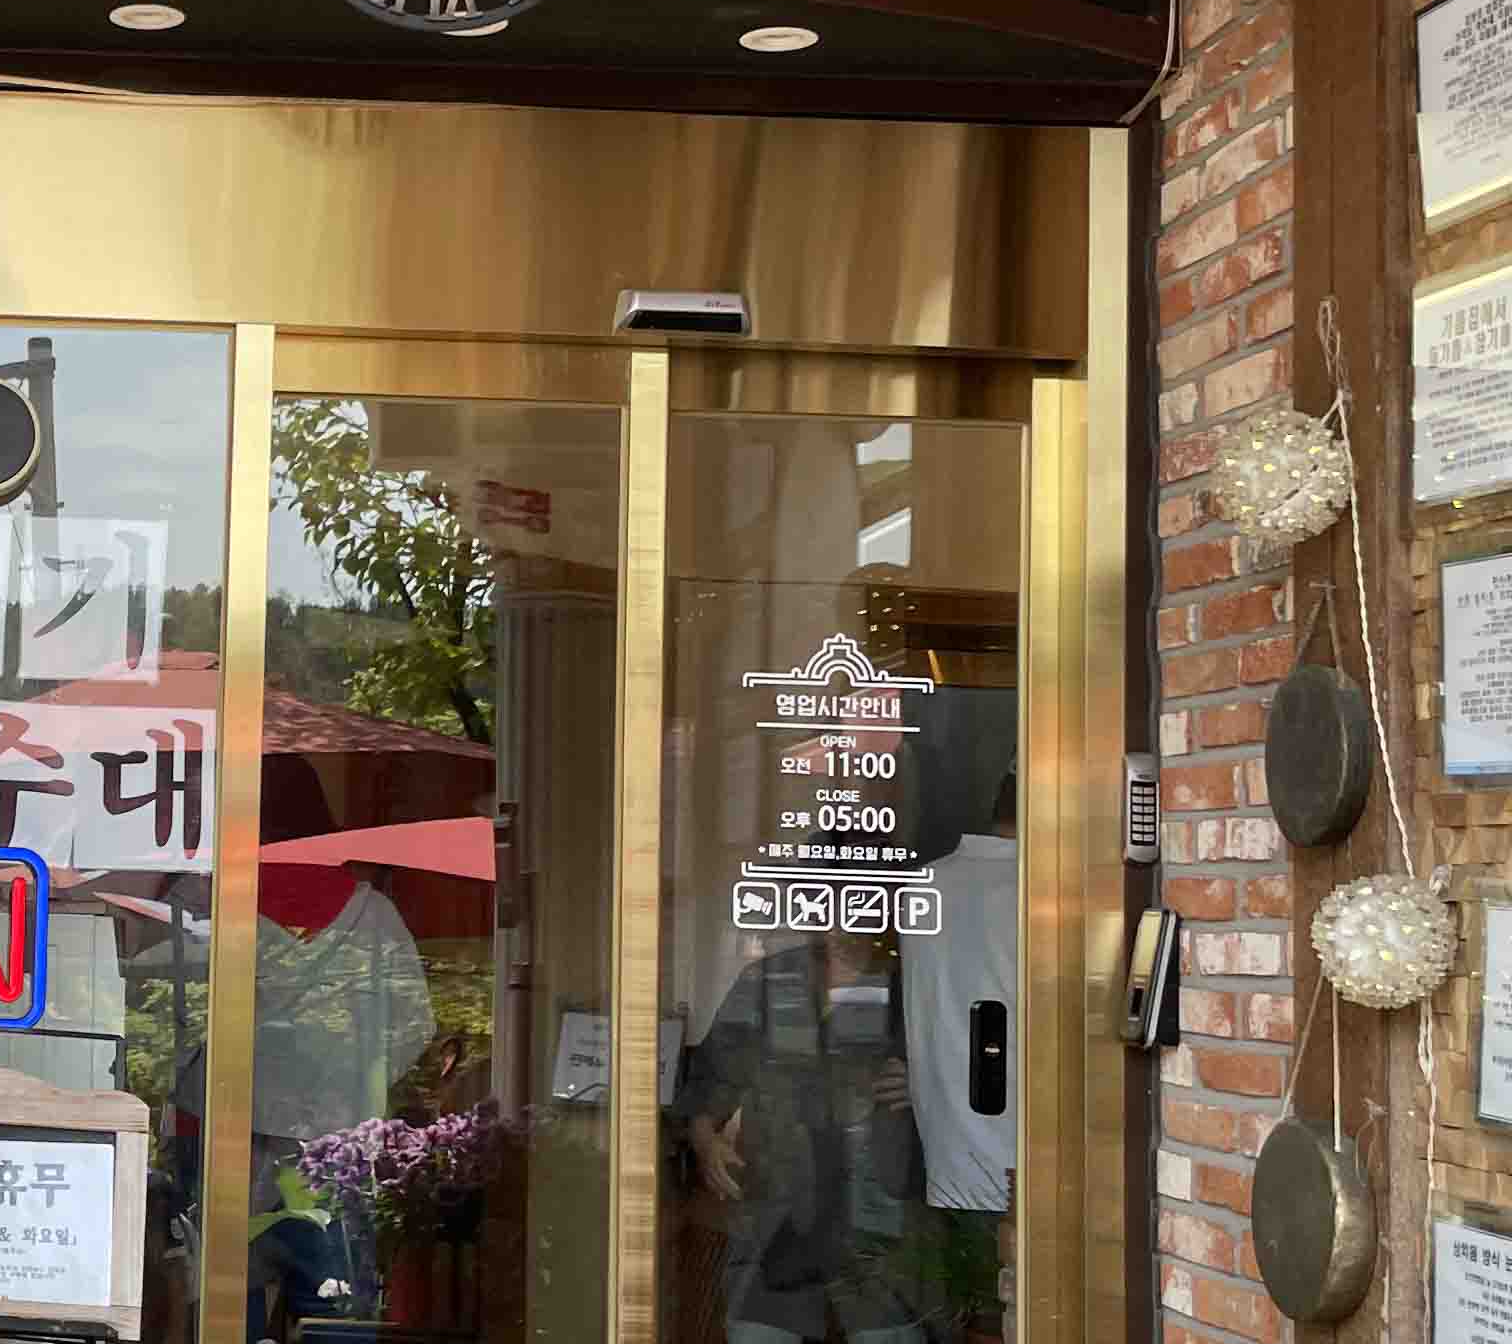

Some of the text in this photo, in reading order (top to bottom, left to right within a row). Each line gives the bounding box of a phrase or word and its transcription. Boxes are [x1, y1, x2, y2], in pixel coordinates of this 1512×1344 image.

[776, 694, 901, 720] 영업시간안내
[820, 735, 857, 749] OPEN
[780, 751, 896, 779] 오전 11:00
[815, 789, 861, 803] CLOSE
[780, 806, 896, 833] 오후 05:00
